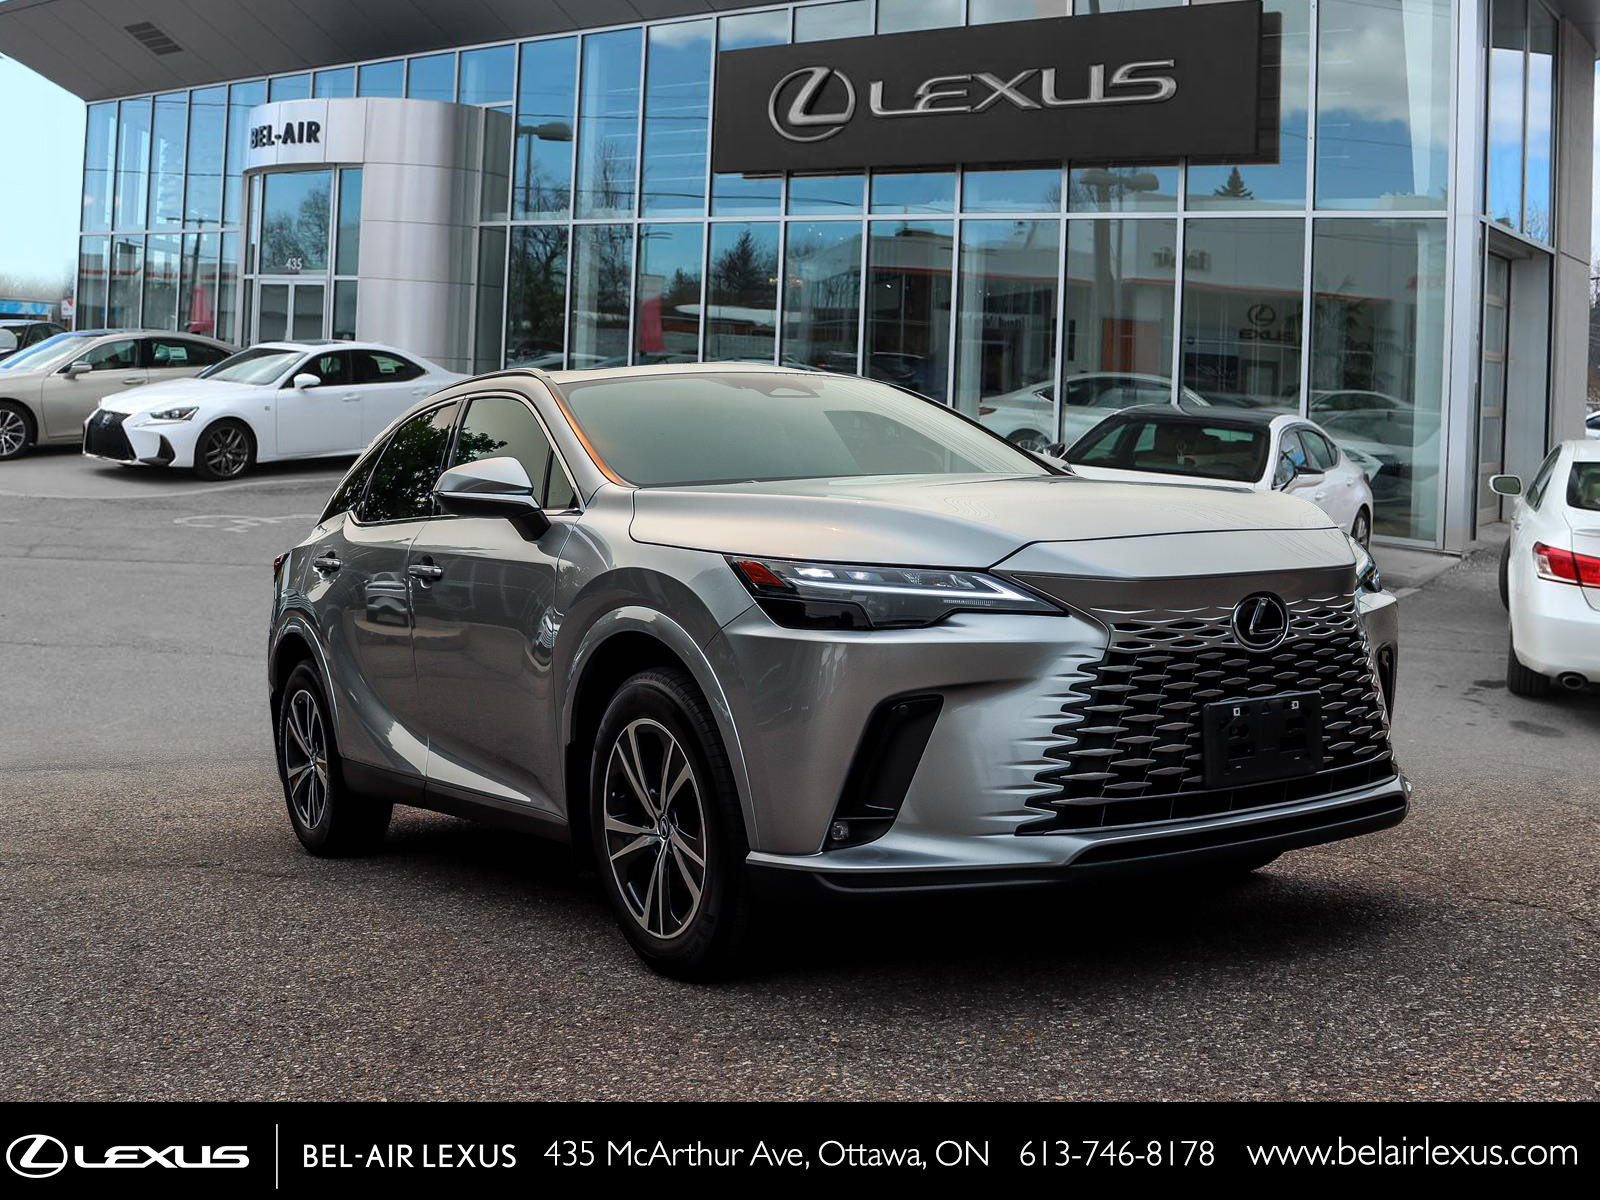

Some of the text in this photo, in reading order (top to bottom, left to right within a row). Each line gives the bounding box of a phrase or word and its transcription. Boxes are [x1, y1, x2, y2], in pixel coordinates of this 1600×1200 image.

[869, 59, 1178, 118] LEXUS
[250, 121, 321, 149] BEL-AIR
[285, 257, 303, 270] 435
